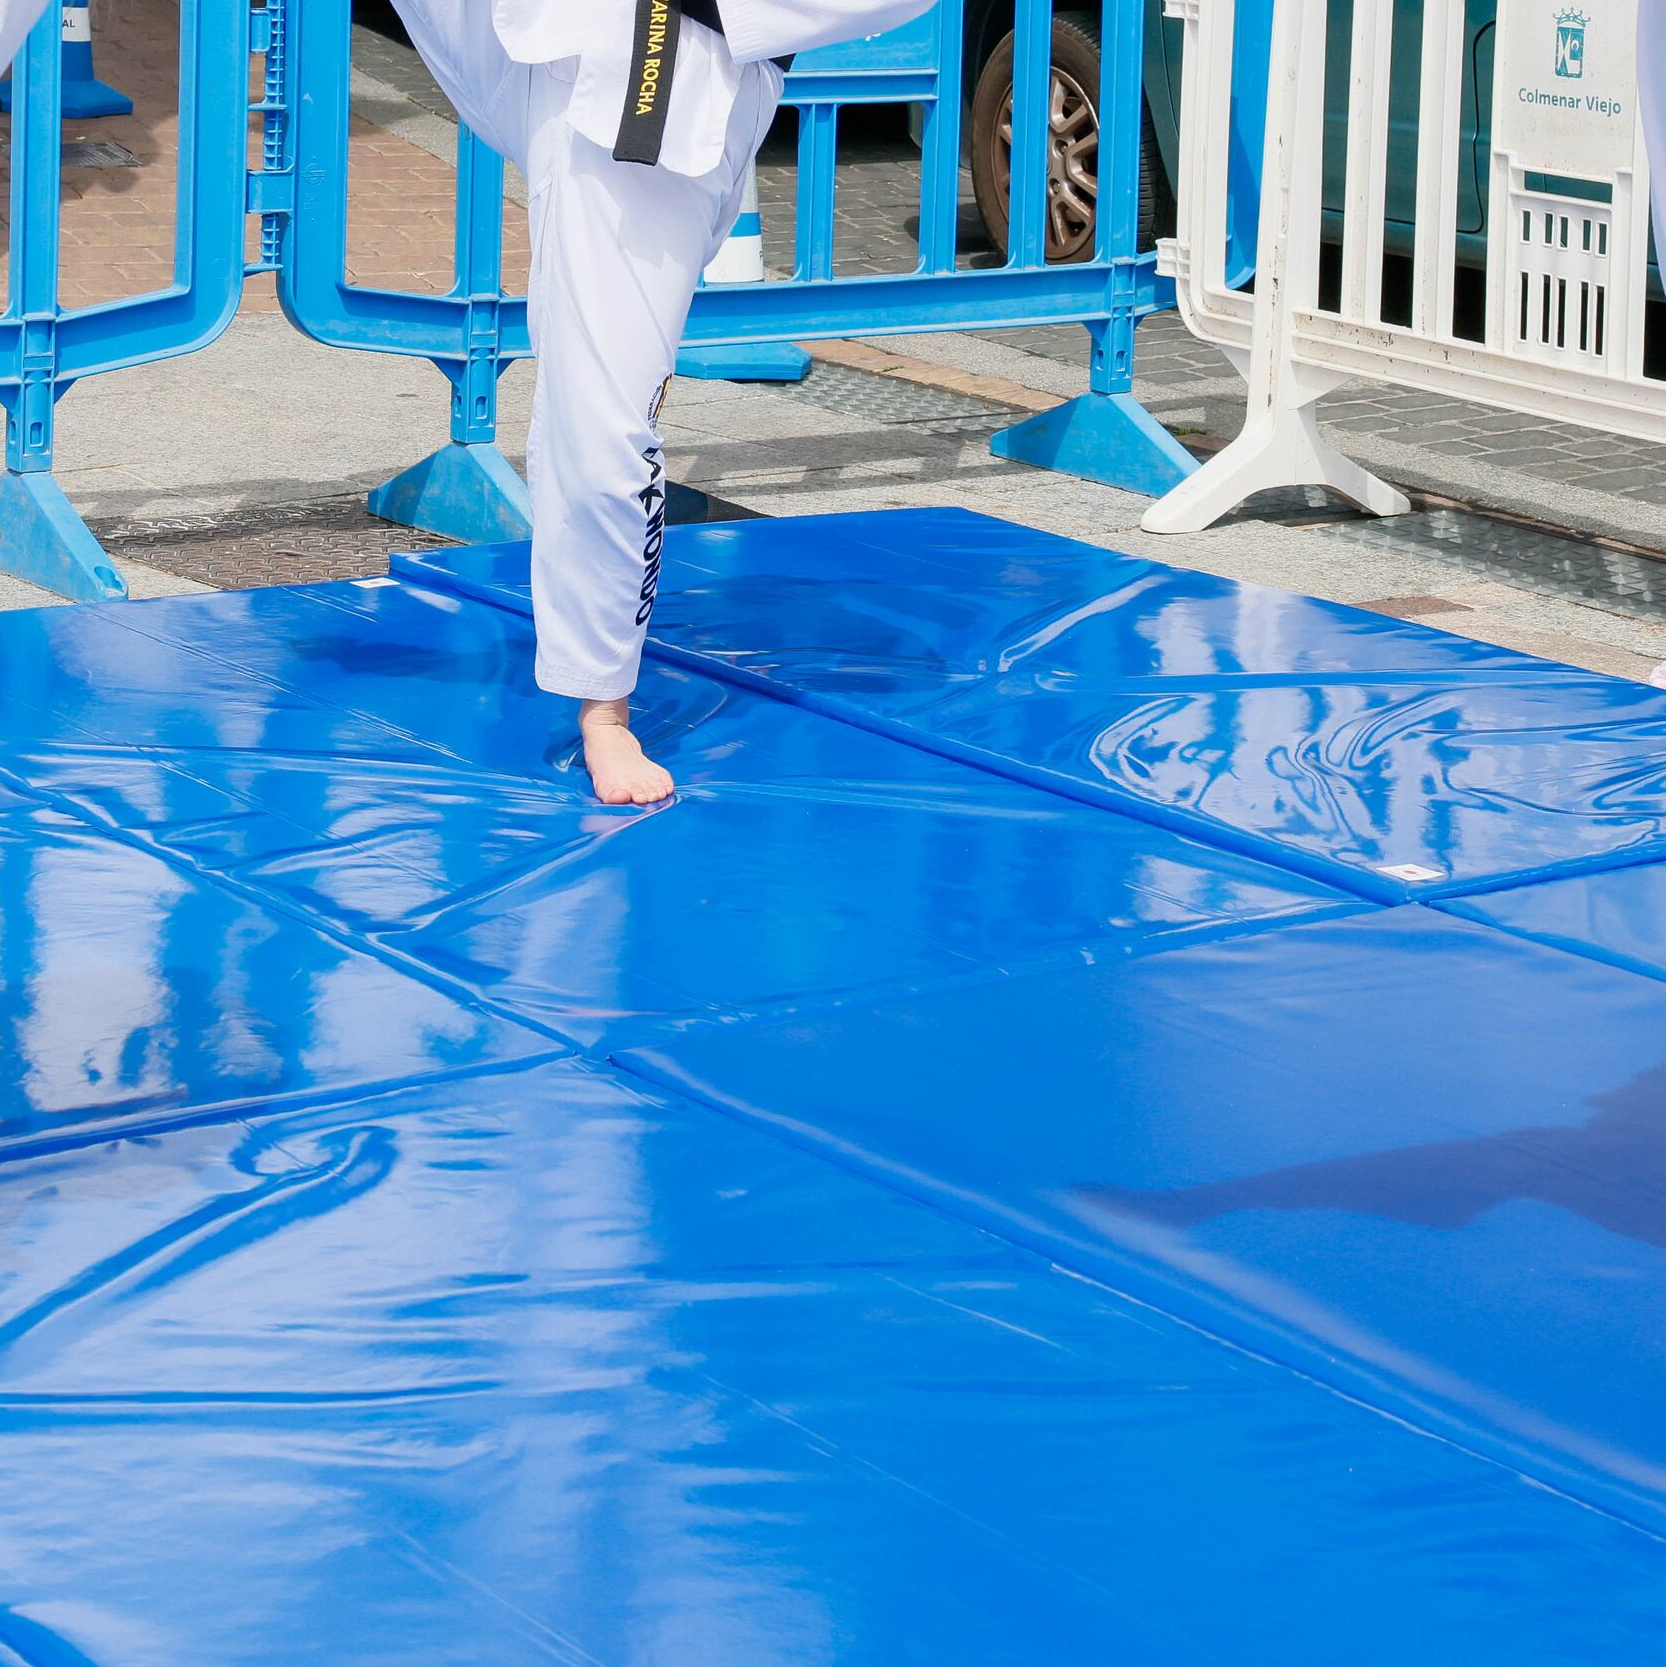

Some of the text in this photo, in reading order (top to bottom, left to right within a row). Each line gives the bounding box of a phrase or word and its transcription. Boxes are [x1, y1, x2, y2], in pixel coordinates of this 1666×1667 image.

[635, 58, 662, 116] ROCHA
[1517, 87, 1622, 117] Colmenar Viejo
[635, 446, 666, 627] TAKWONDO
